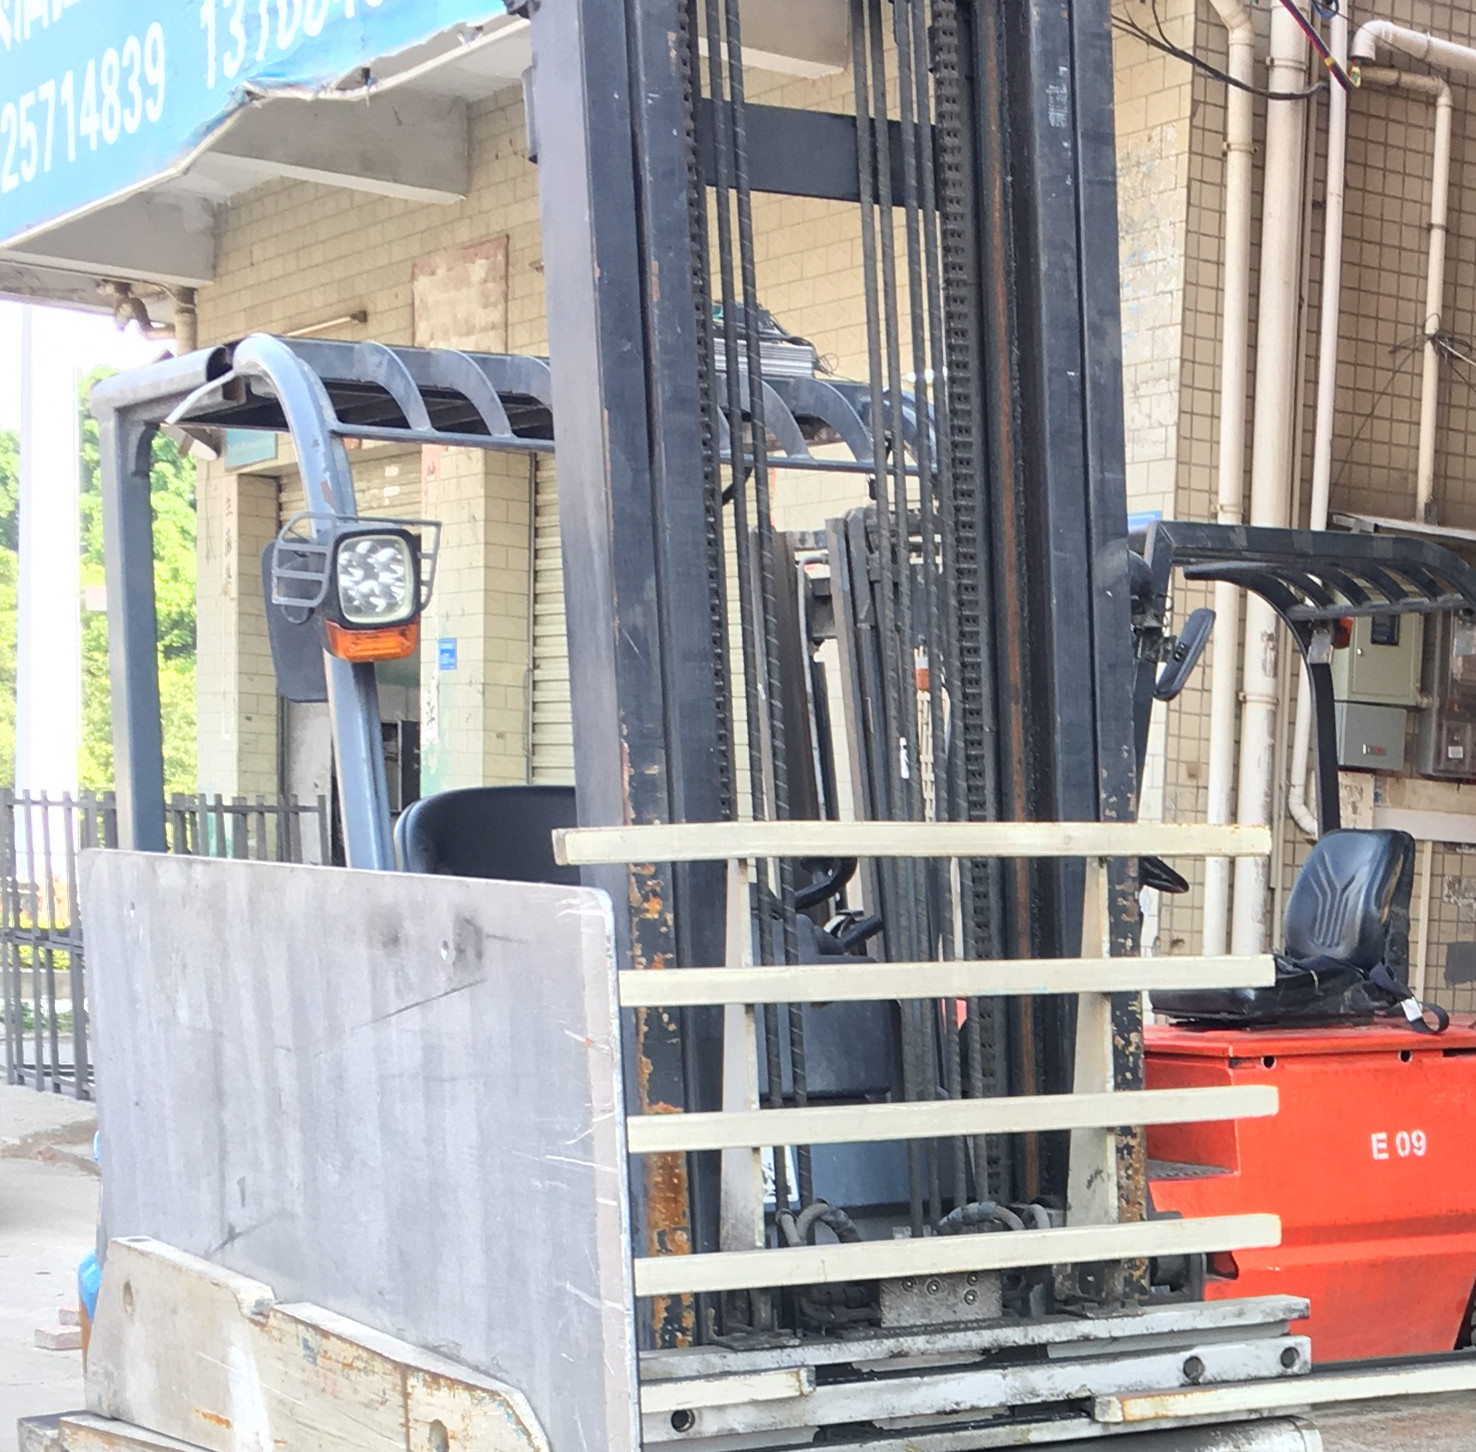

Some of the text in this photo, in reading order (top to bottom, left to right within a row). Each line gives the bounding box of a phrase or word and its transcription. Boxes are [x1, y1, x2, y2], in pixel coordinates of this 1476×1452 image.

[1, 21, 165, 193] 25714839
[1371, 1129, 1426, 1160] E 09
